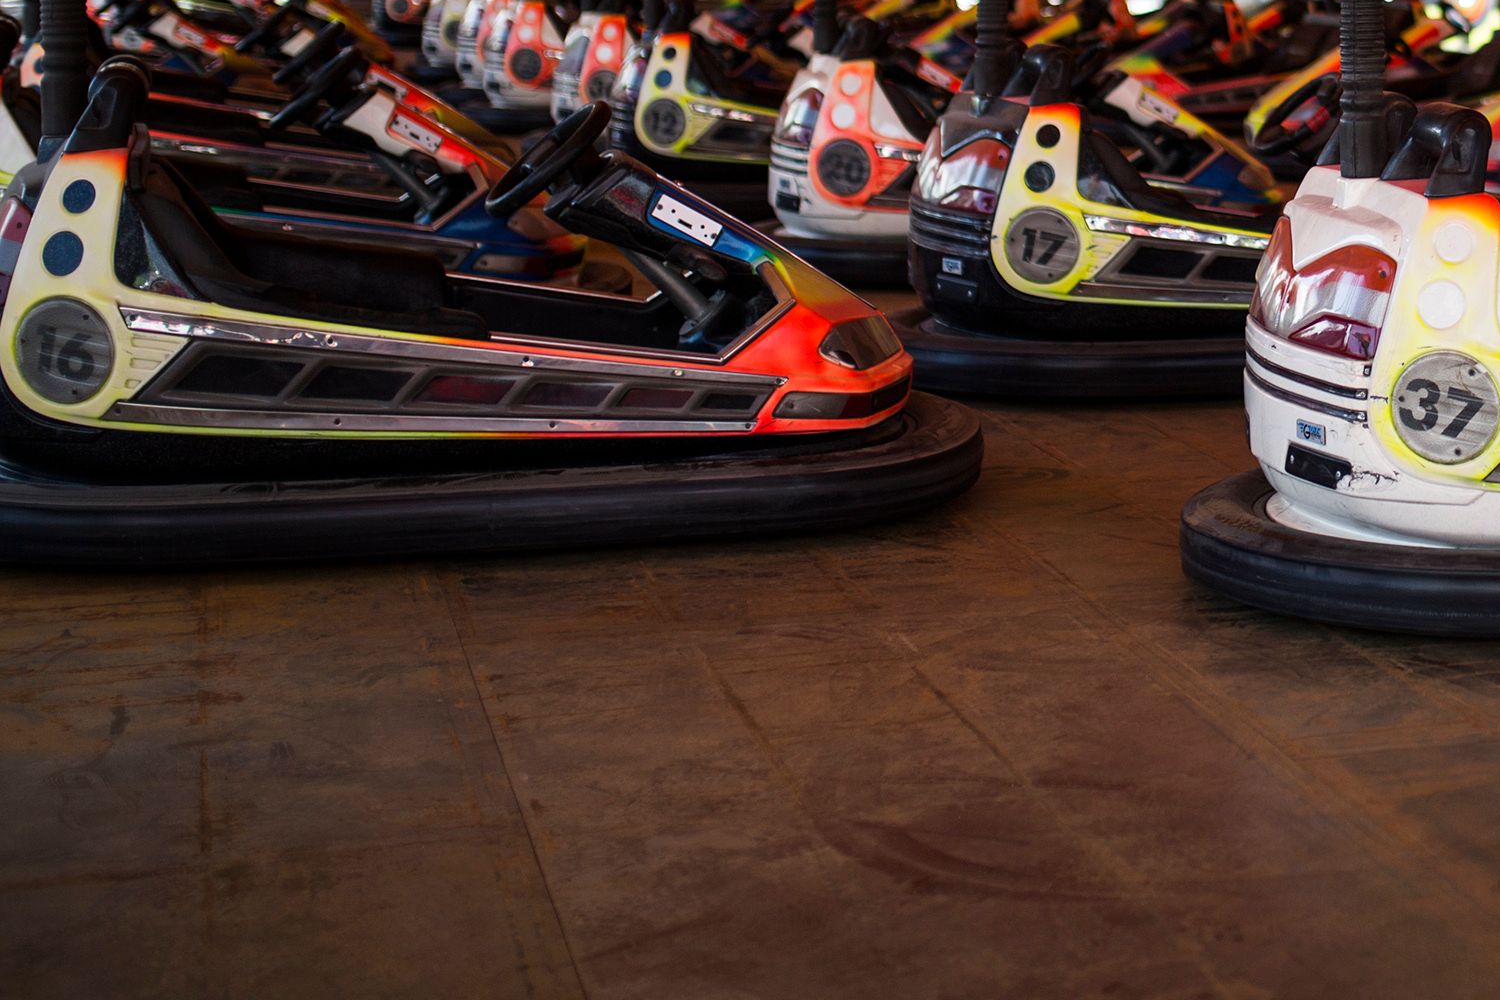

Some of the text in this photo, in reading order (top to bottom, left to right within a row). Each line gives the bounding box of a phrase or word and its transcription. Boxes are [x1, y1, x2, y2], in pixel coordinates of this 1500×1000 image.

[651, 110, 679, 137] 12
[1021, 228, 1069, 267] 17
[36, 324, 96, 381] 16
[1399, 377, 1485, 439] 37
